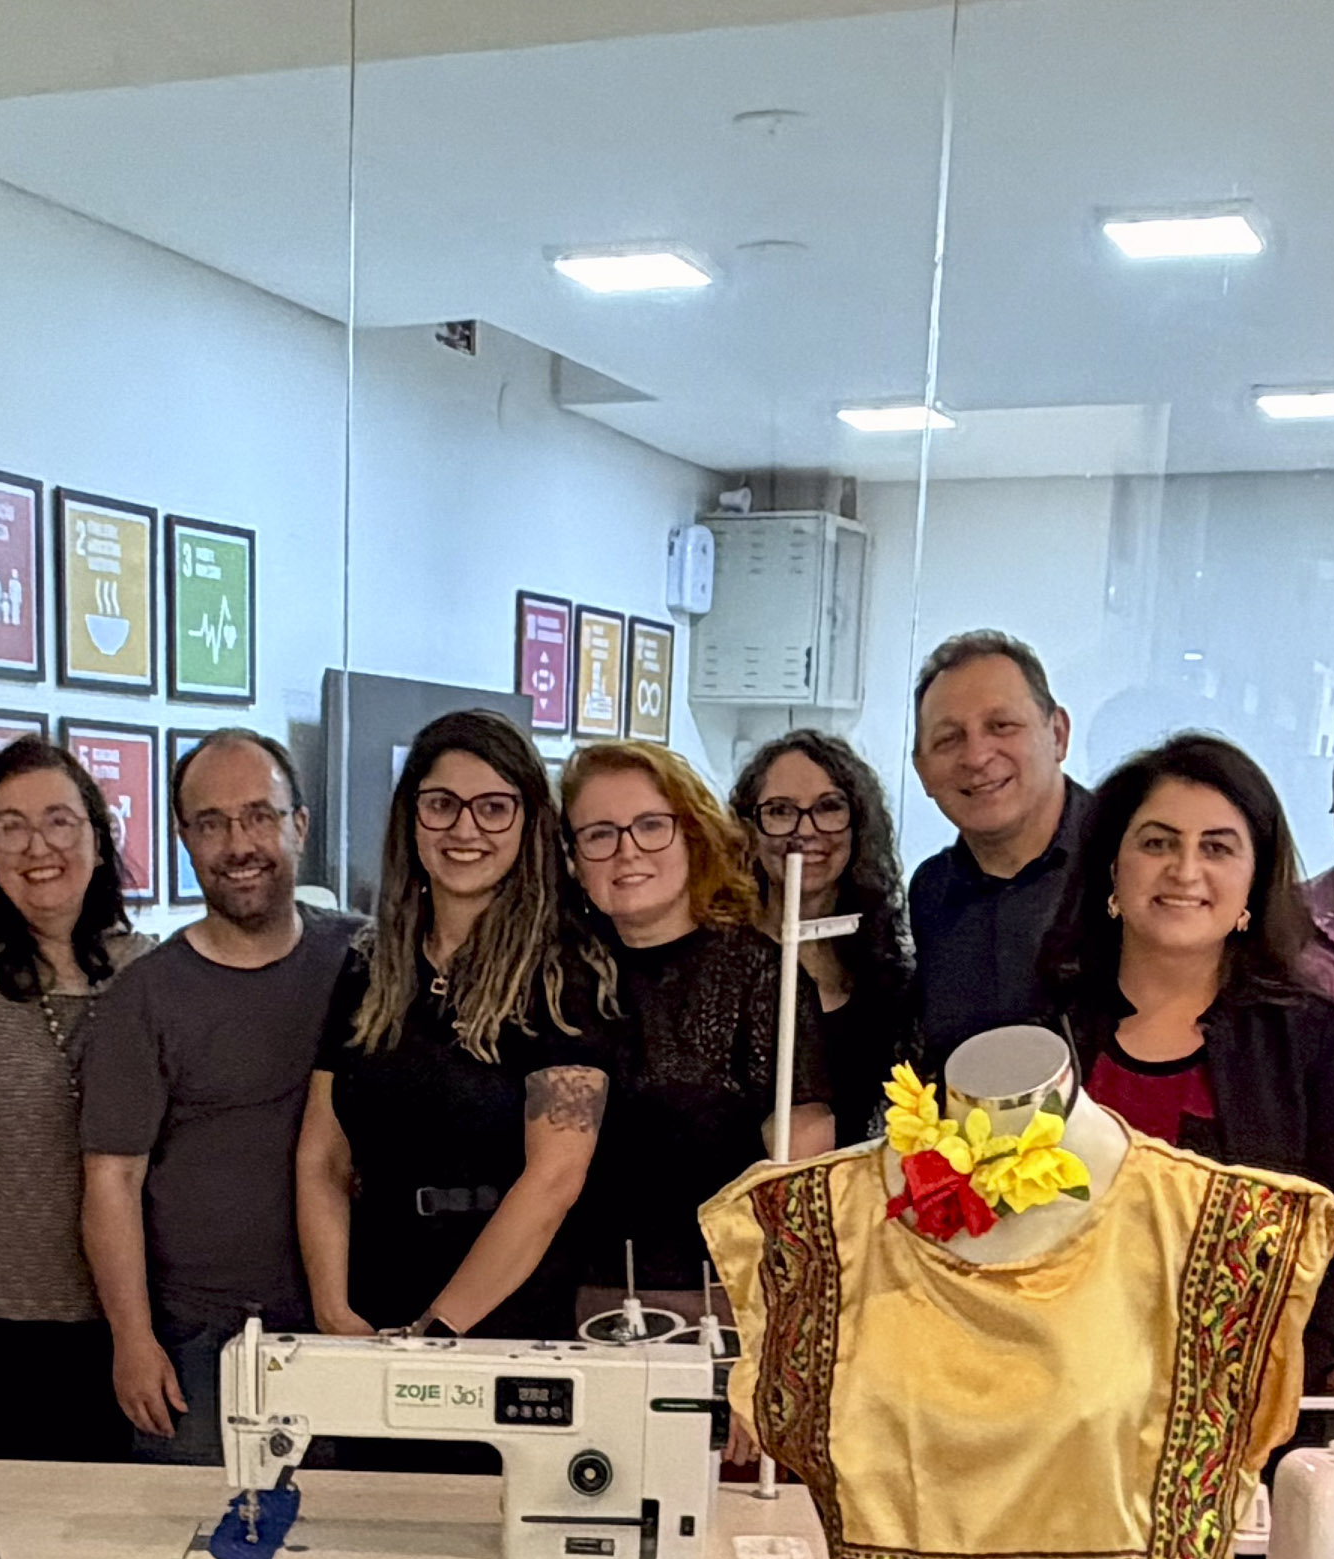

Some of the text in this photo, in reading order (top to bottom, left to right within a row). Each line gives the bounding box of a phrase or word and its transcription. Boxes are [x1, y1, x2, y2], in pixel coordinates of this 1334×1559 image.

[76, 519, 88, 557] 2
[182, 542, 193, 578] 3
[395, 1384, 441, 1402] ZOJE
